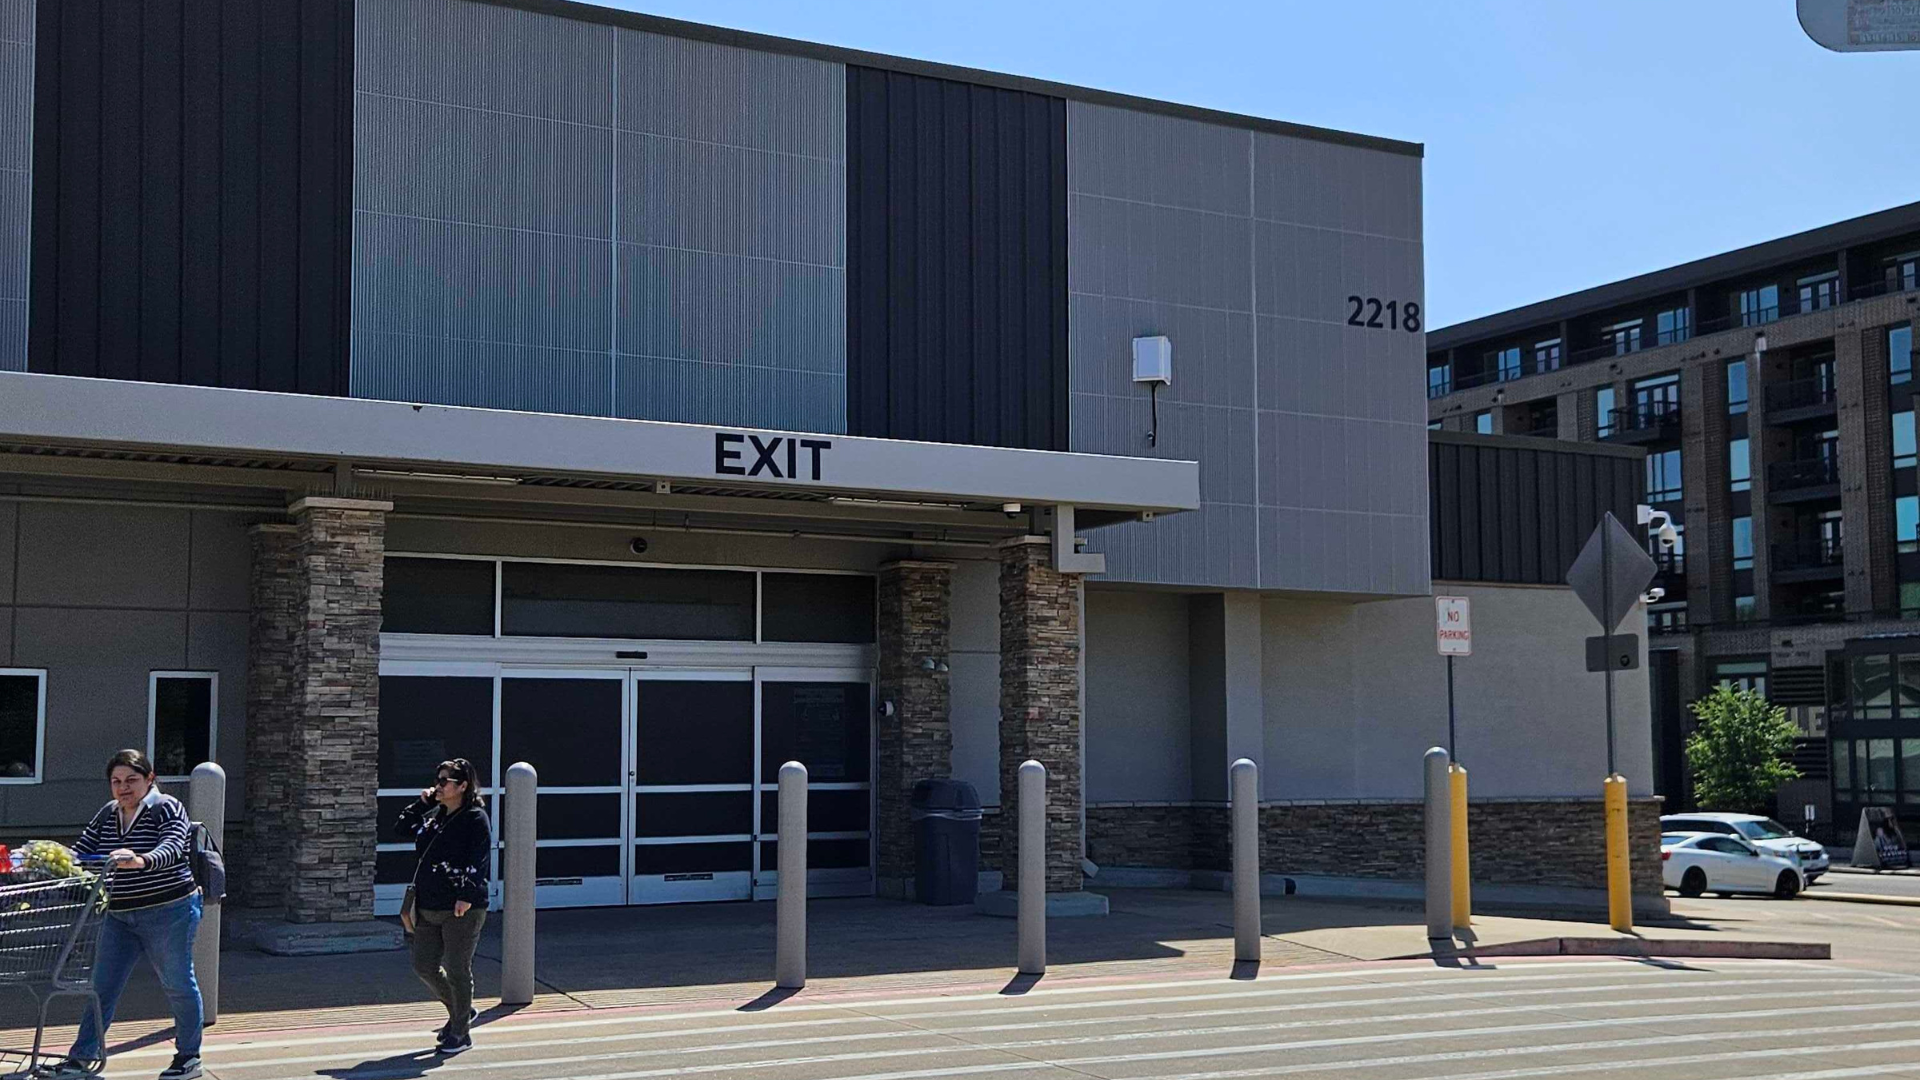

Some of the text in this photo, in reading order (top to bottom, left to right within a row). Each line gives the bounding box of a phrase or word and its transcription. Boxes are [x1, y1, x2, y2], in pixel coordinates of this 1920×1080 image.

[1347, 295, 1421, 333] 2218
[715, 432, 832, 481] EXIT
[1447, 610, 1460, 622] NO
[1439, 629, 1470, 641] PARKING
